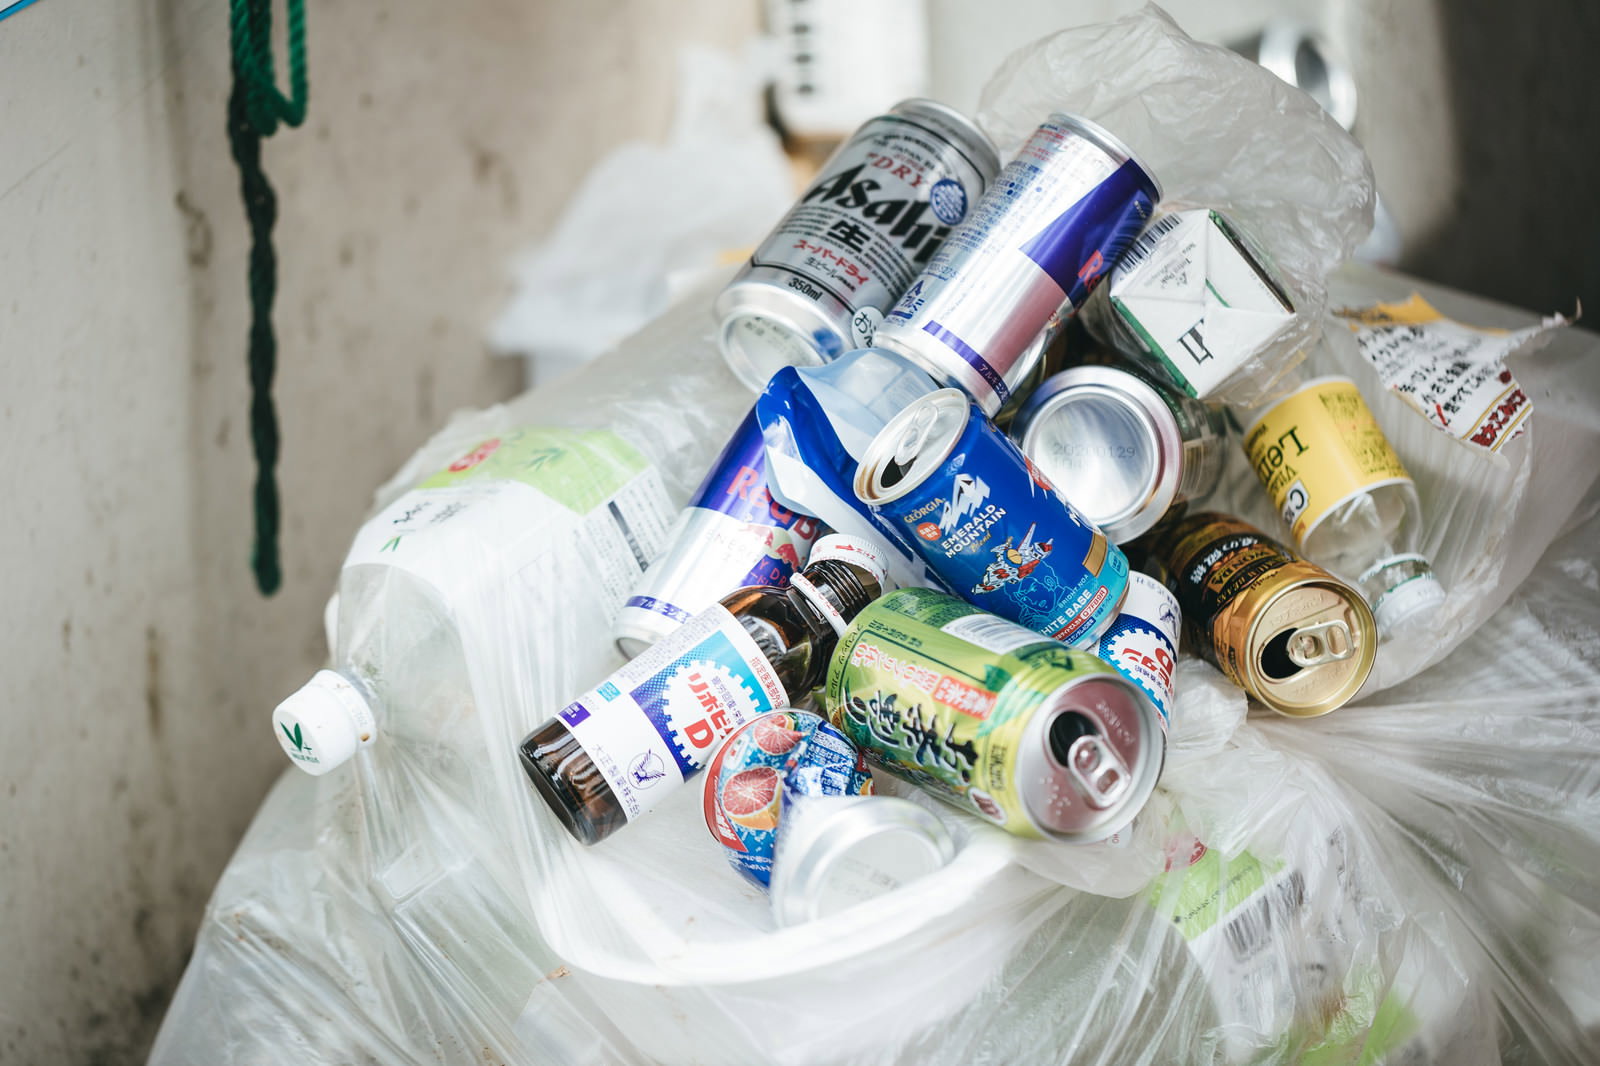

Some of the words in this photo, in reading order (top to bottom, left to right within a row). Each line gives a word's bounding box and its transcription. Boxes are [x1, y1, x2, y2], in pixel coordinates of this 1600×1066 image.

[803, 163, 951, 263] Asahi
[827, 219, 872, 253] 生
[792, 239, 870, 285] スーパードライ
[788, 277, 824, 301] 350ml
[941, 504, 997, 549] EMERALD
[946, 509, 1007, 559] MOUNTAIN
[971, 532, 993, 554] Blend
[1038, 612, 1067, 640] HITE
[1064, 588, 1093, 617] BASE
[683, 718, 715, 749] D
[844, 688, 979, 784] お茶割り
